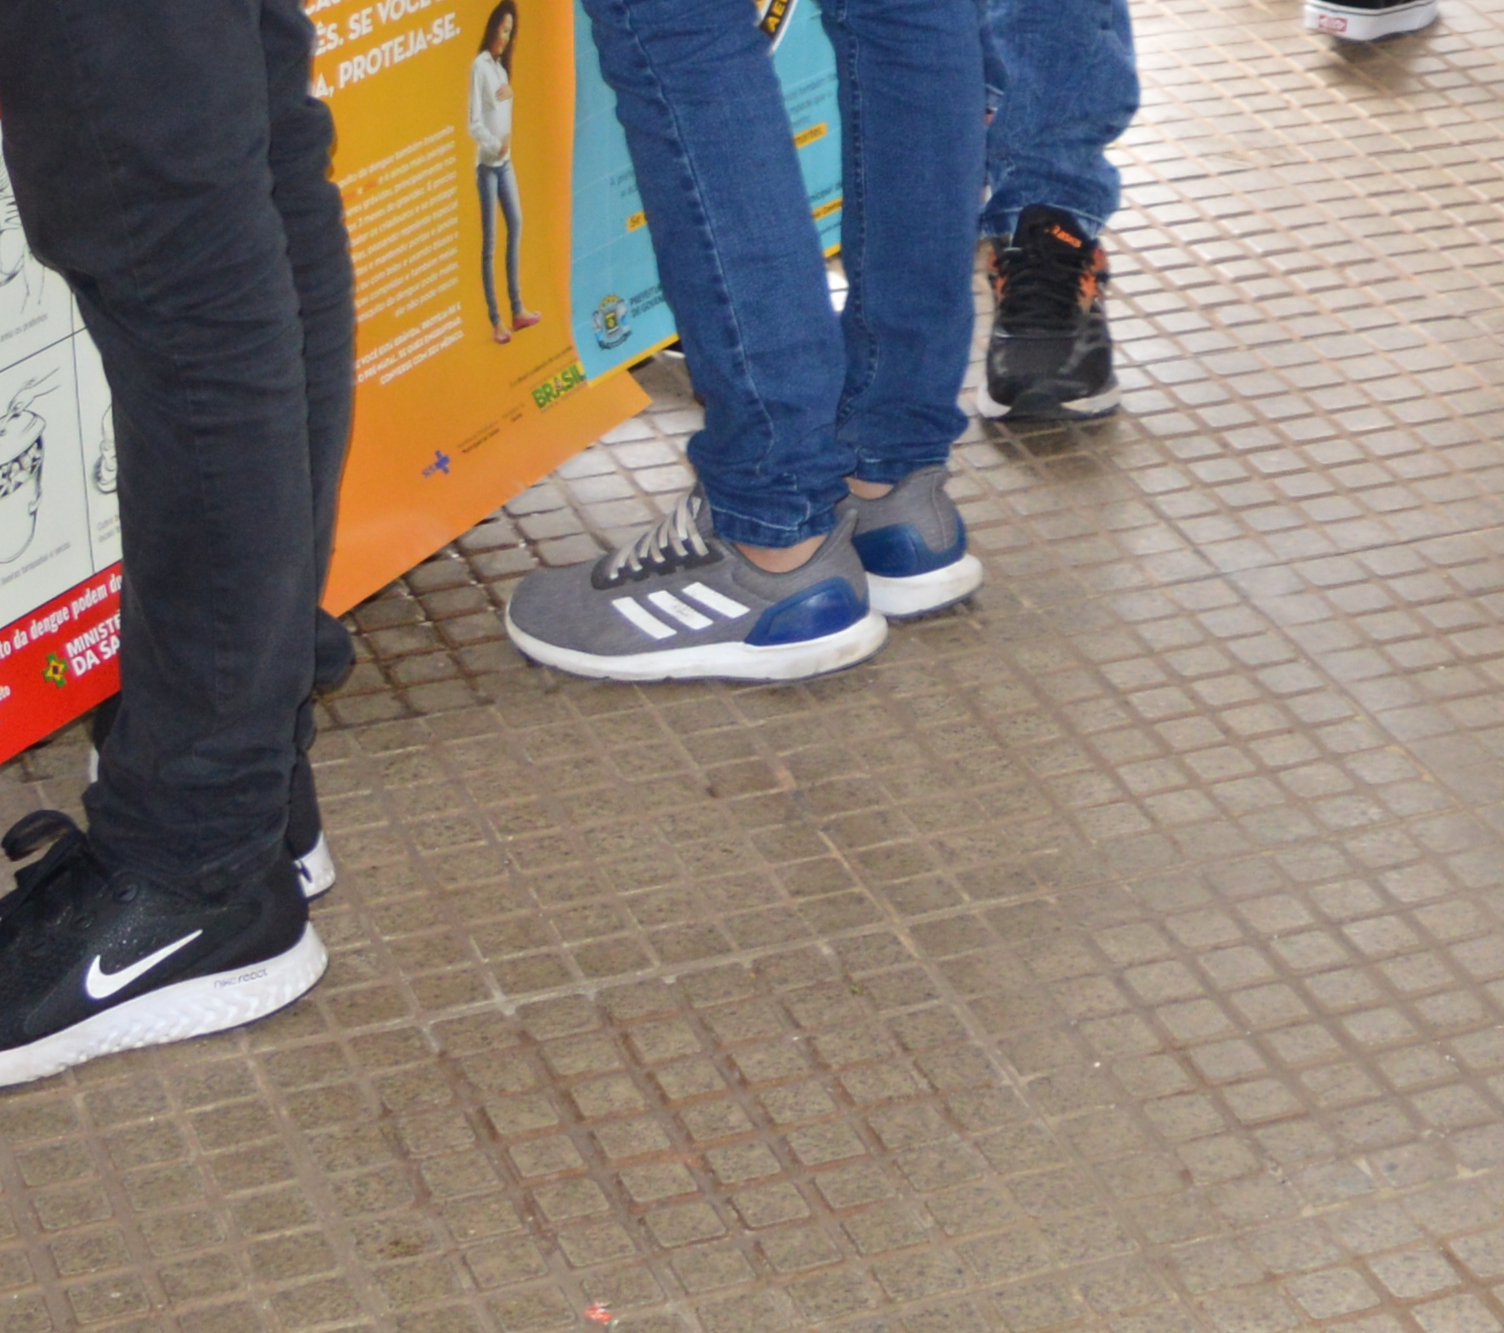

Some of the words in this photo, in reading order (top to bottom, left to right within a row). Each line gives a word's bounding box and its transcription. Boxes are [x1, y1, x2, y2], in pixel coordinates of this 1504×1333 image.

[348, 7, 373, 40] SE
[339, 12, 461, 89] PROTEJA-SE.
[531, 362, 585, 409] BRASIL
[13, 629, 29, 650] da
[30, 611, 70, 640] dengue
[71, 584, 108, 620] podem
[71, 651, 101, 677] DA
